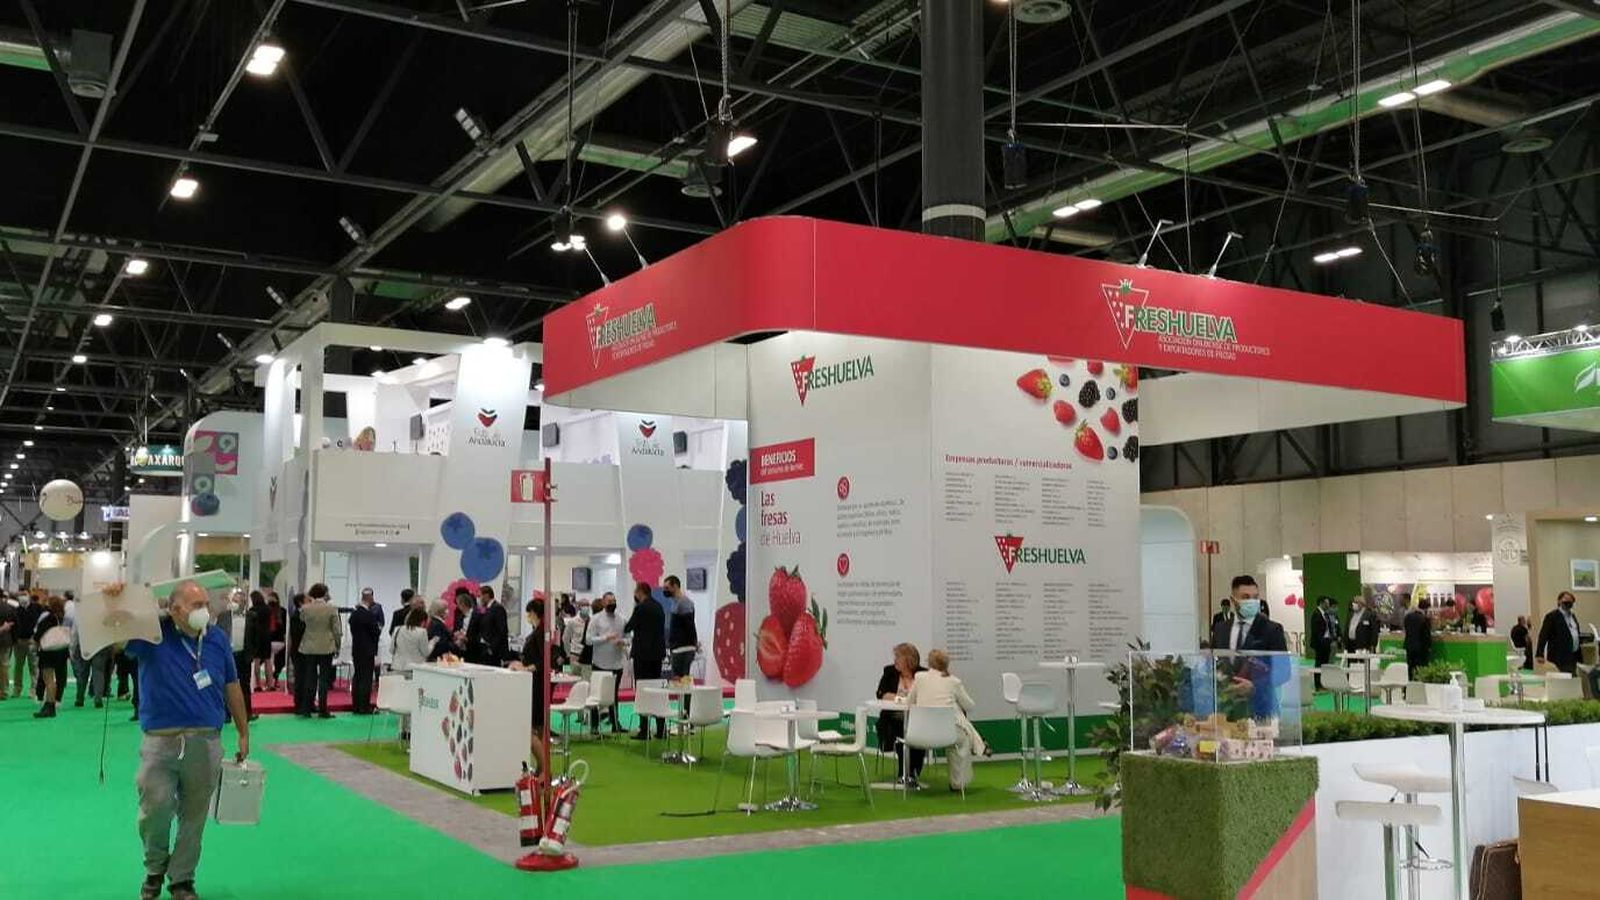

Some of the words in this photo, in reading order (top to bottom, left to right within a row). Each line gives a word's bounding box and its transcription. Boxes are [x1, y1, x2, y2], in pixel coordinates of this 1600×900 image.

[594, 303, 657, 349] FRESHUELVA
[1125, 304, 1238, 343] FRESHUELVA
[801, 355, 874, 392] FRESHUELVA
[945, 454, 976, 464] Empresas
[977, 457, 1013, 467] productoras
[761, 490, 775, 507] Las
[761, 509, 788, 527] fresas
[761, 531, 771, 547] de
[772, 528, 801, 546] Huelva
[1008, 546, 1087, 565] FRESHUELVA
